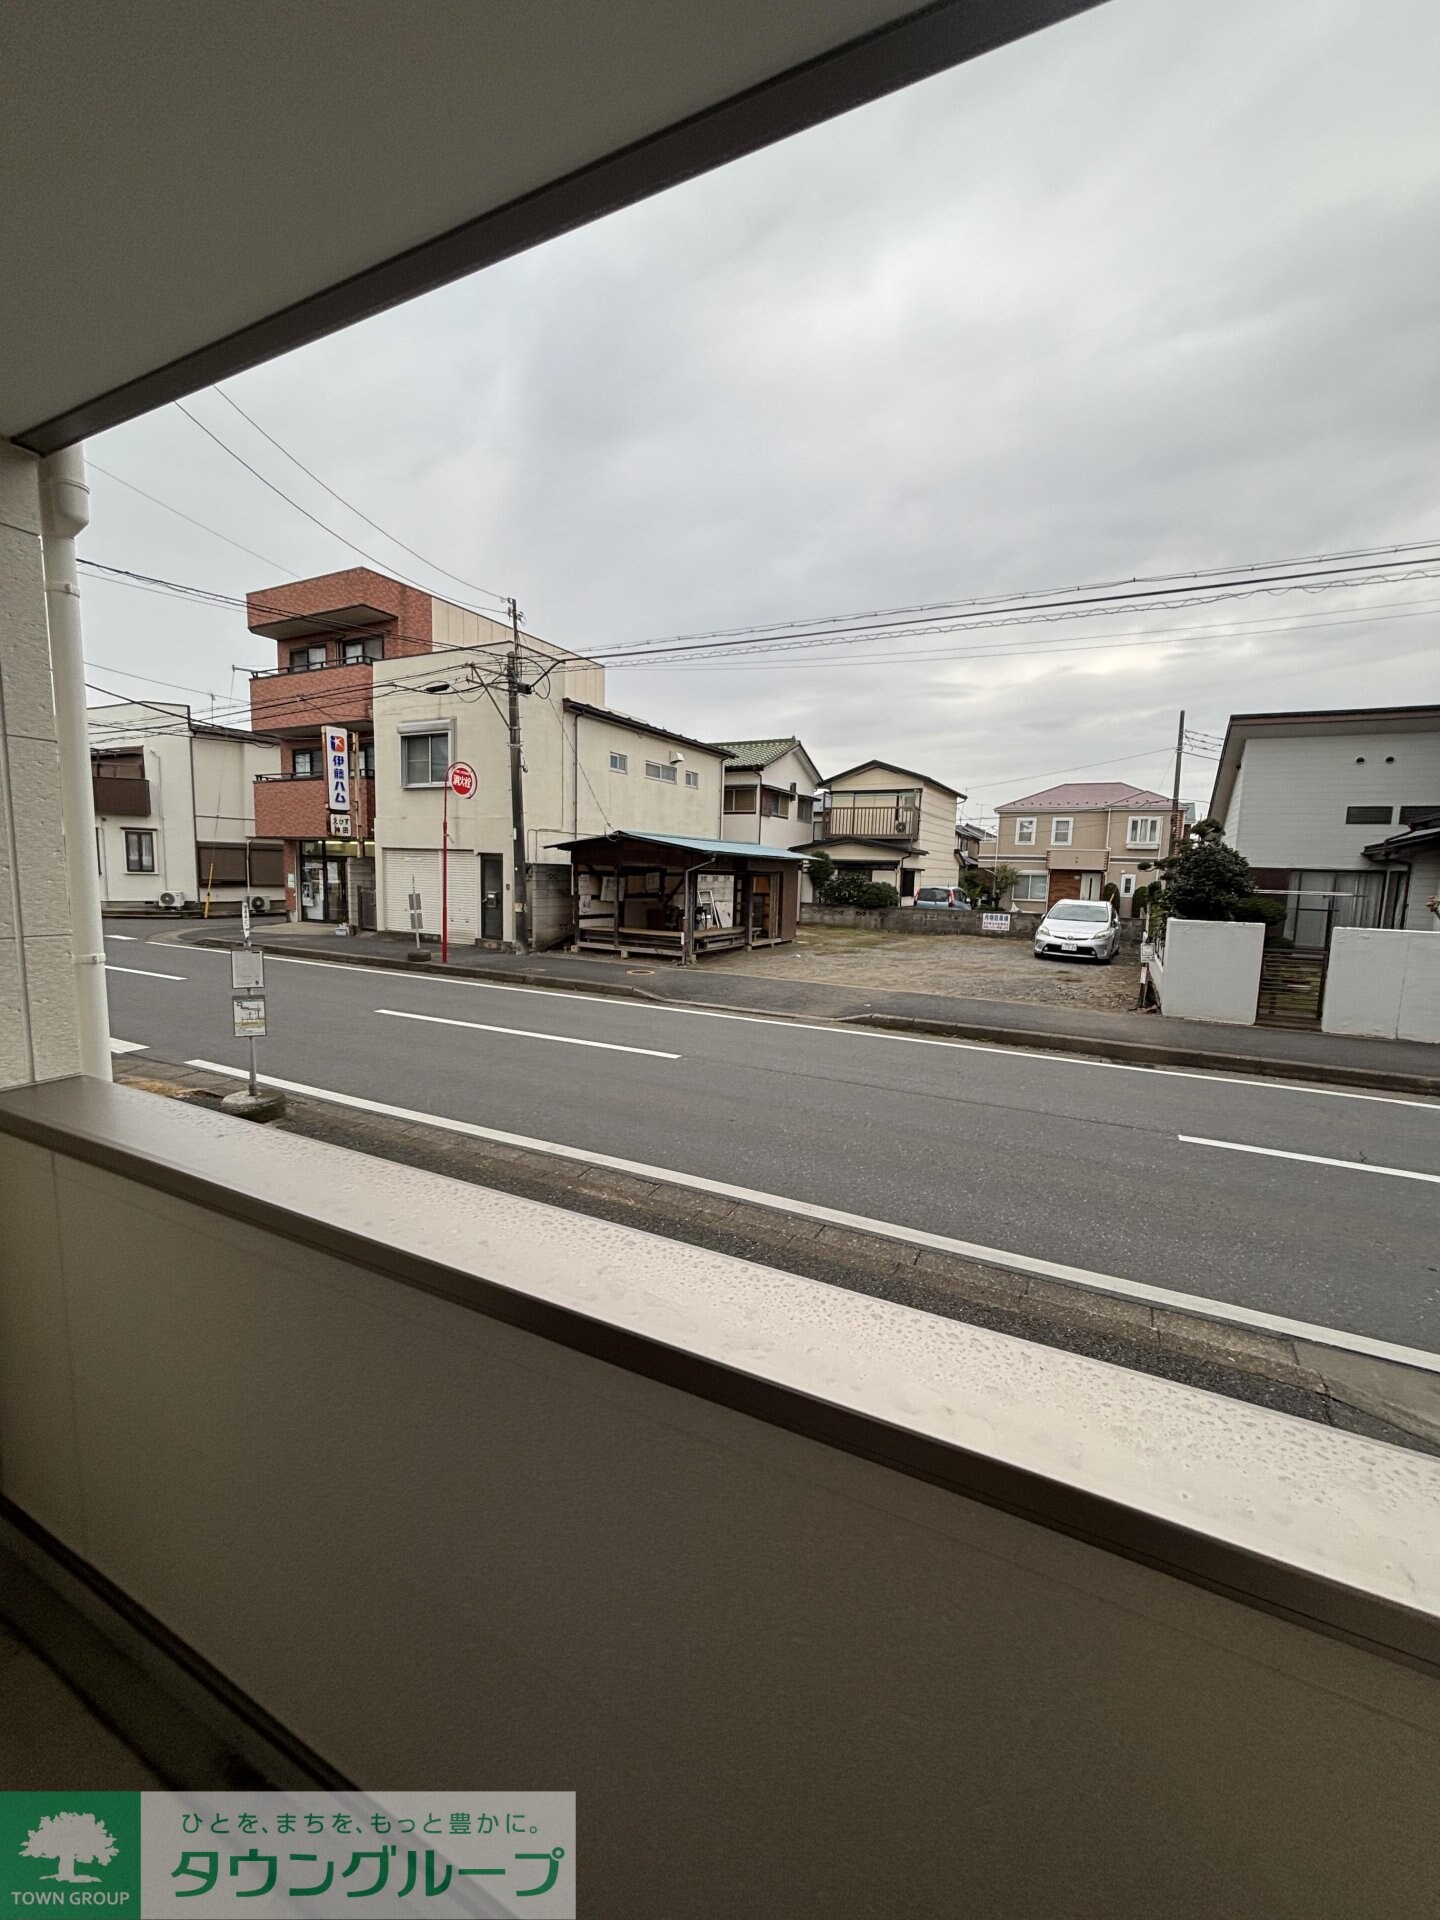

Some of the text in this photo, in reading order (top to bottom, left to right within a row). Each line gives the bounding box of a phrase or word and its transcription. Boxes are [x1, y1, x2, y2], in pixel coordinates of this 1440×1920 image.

[333, 755, 346, 803] 伊藤ハム
[452, 773, 472, 789] 消火栓
